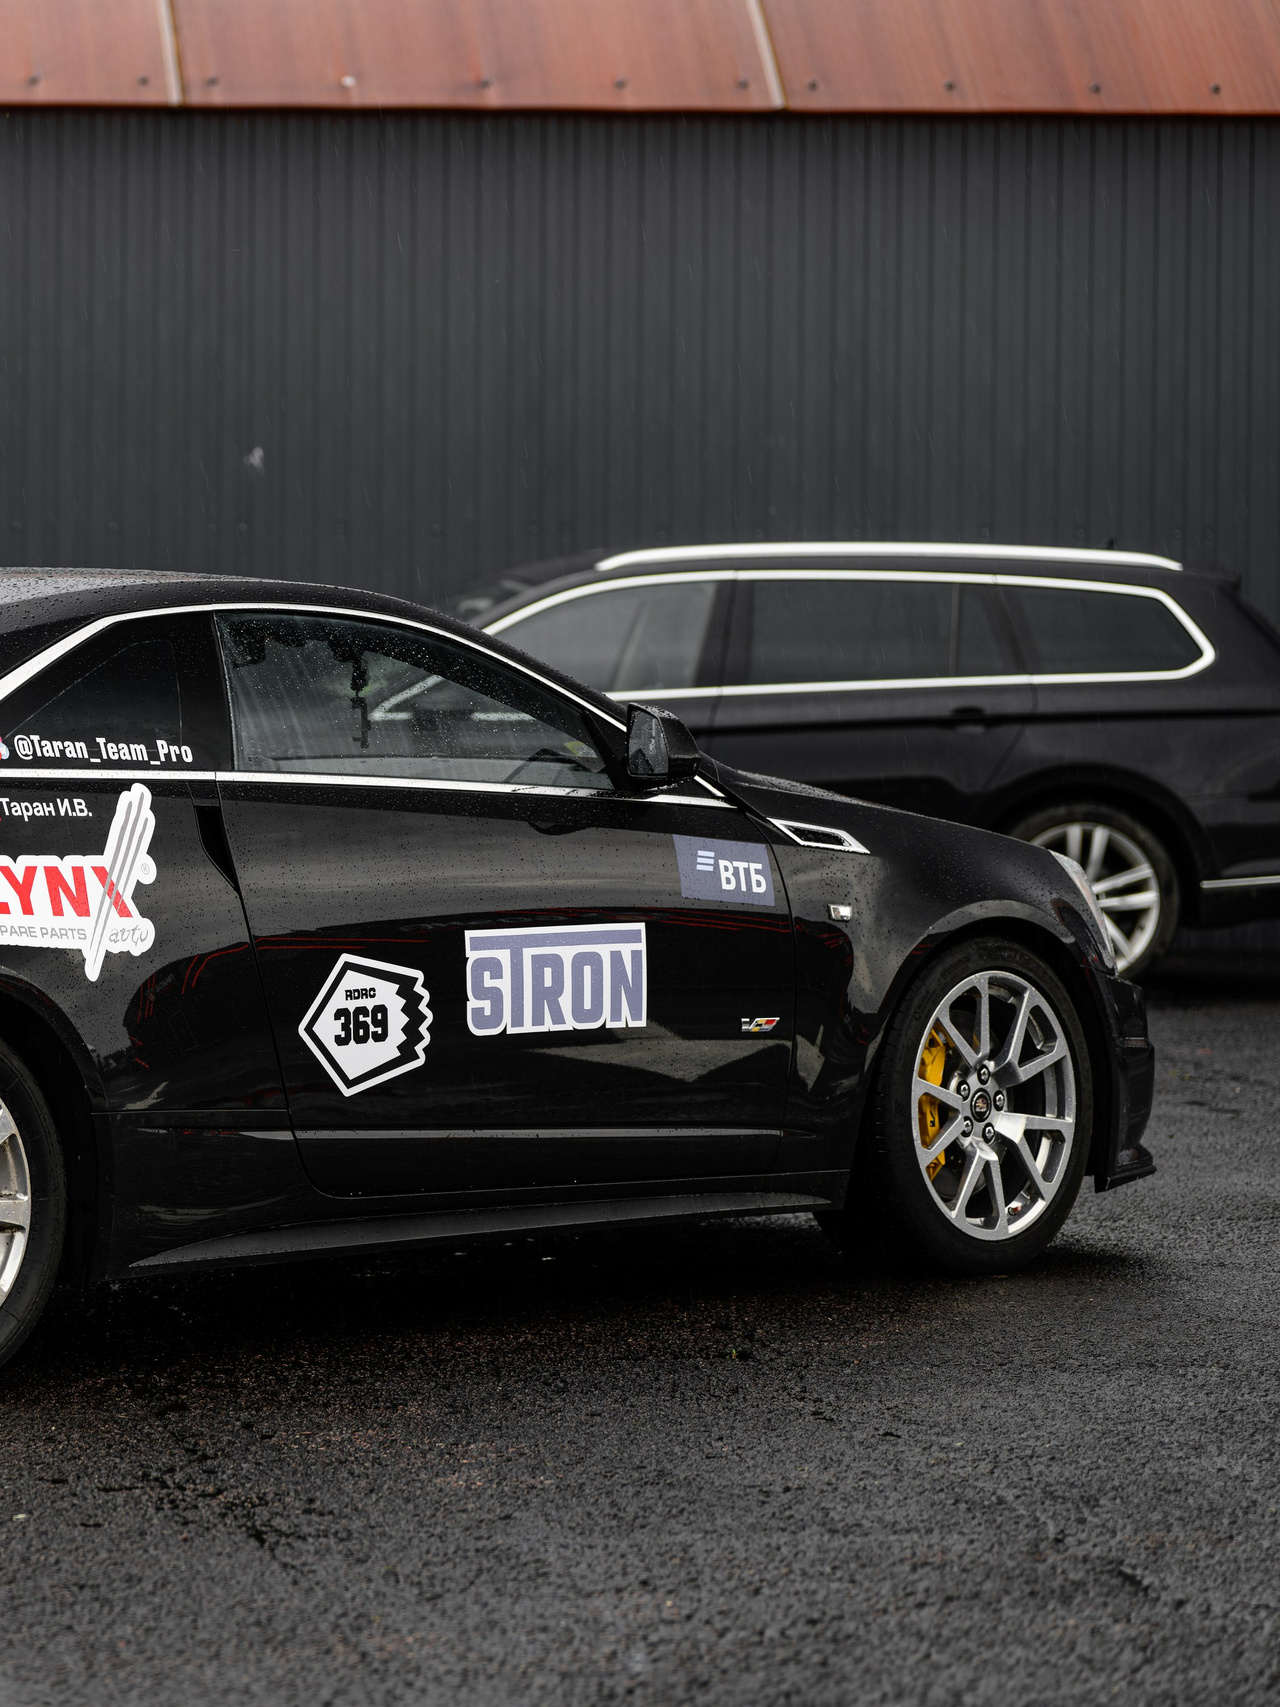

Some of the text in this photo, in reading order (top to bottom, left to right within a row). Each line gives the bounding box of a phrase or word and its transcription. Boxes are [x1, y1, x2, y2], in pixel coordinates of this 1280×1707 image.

[13, 733, 194, 766] @Taran_Team_Pro
[57, 798, 93, 817] И.В.
[718, 859, 767, 894] ВТБ
[40, 926, 88, 941] PARTS
[345, 987, 377, 1001] RDRC
[469, 929, 643, 1030] STRON
[333, 1004, 389, 1047] 369
